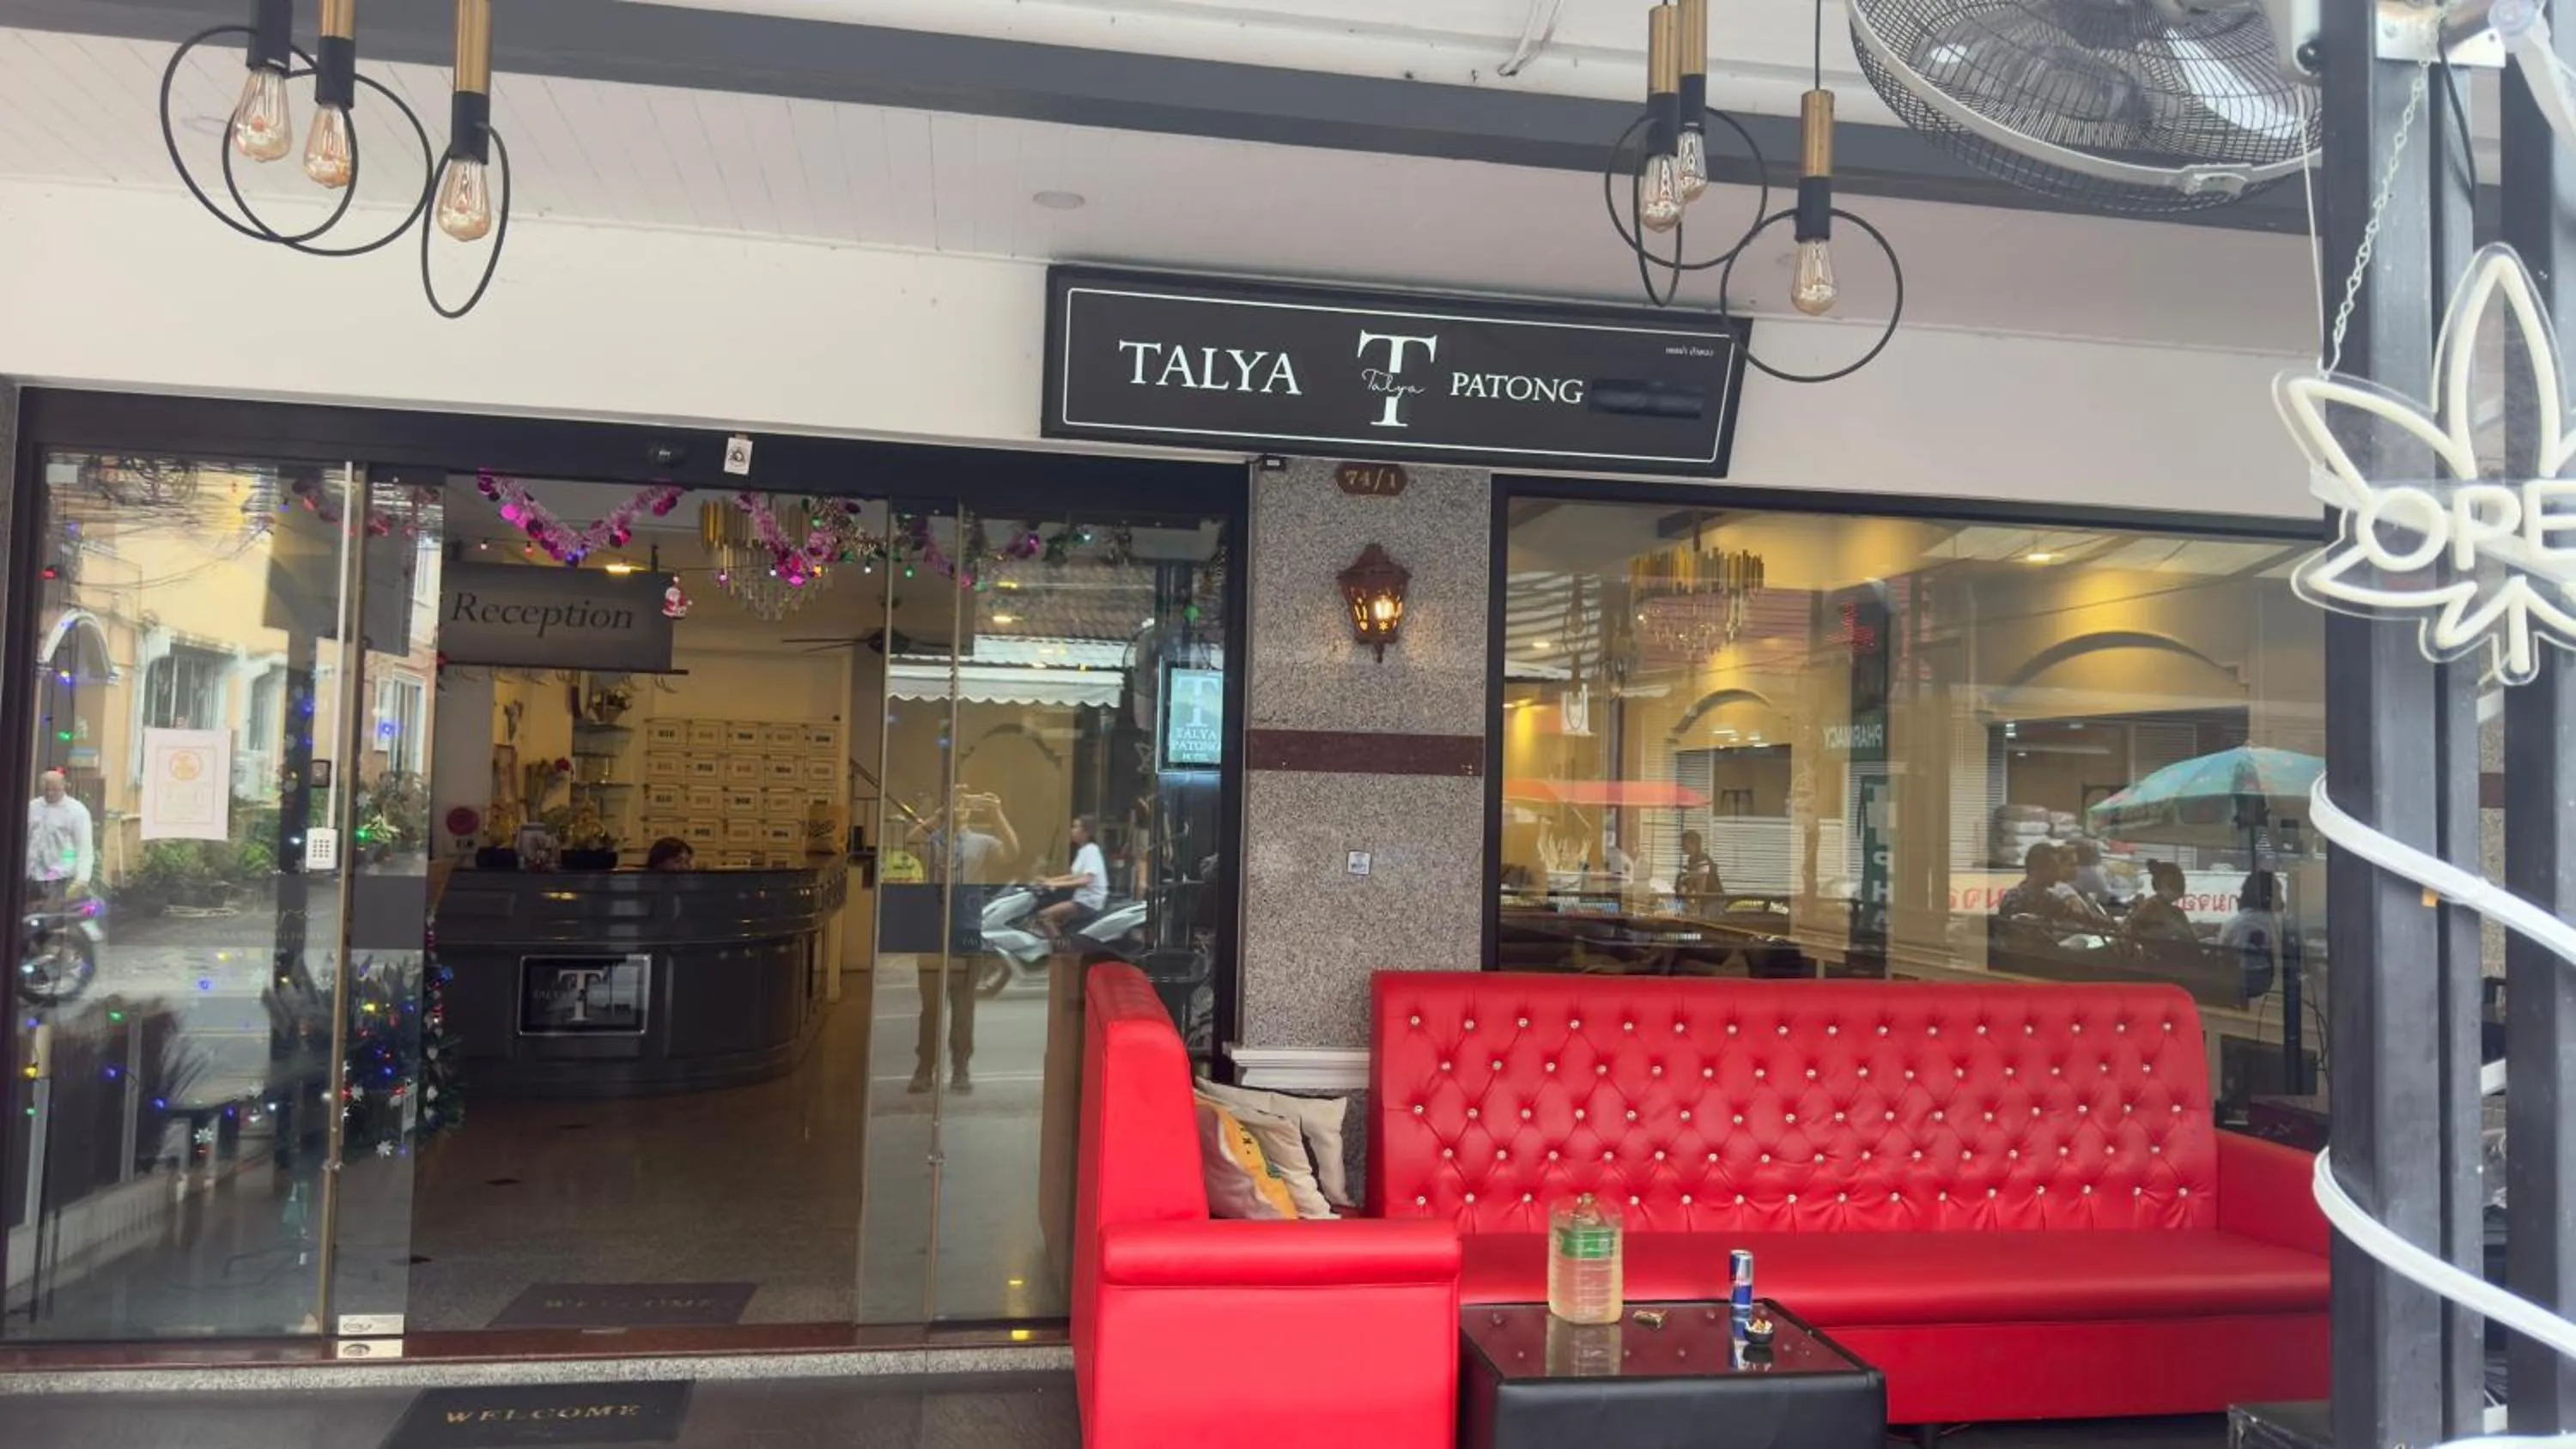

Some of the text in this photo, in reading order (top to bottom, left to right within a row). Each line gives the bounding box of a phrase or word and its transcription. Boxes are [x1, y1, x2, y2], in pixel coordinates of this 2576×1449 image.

[1119, 339, 1302, 395] TALYA
[1358, 329, 1438, 427] T
[1361, 368, 1426, 399] Talya
[1449, 371, 1584, 404] PATONG
[451, 591, 634, 638] Reception
[446, 1404, 641, 1424] WELCOME
